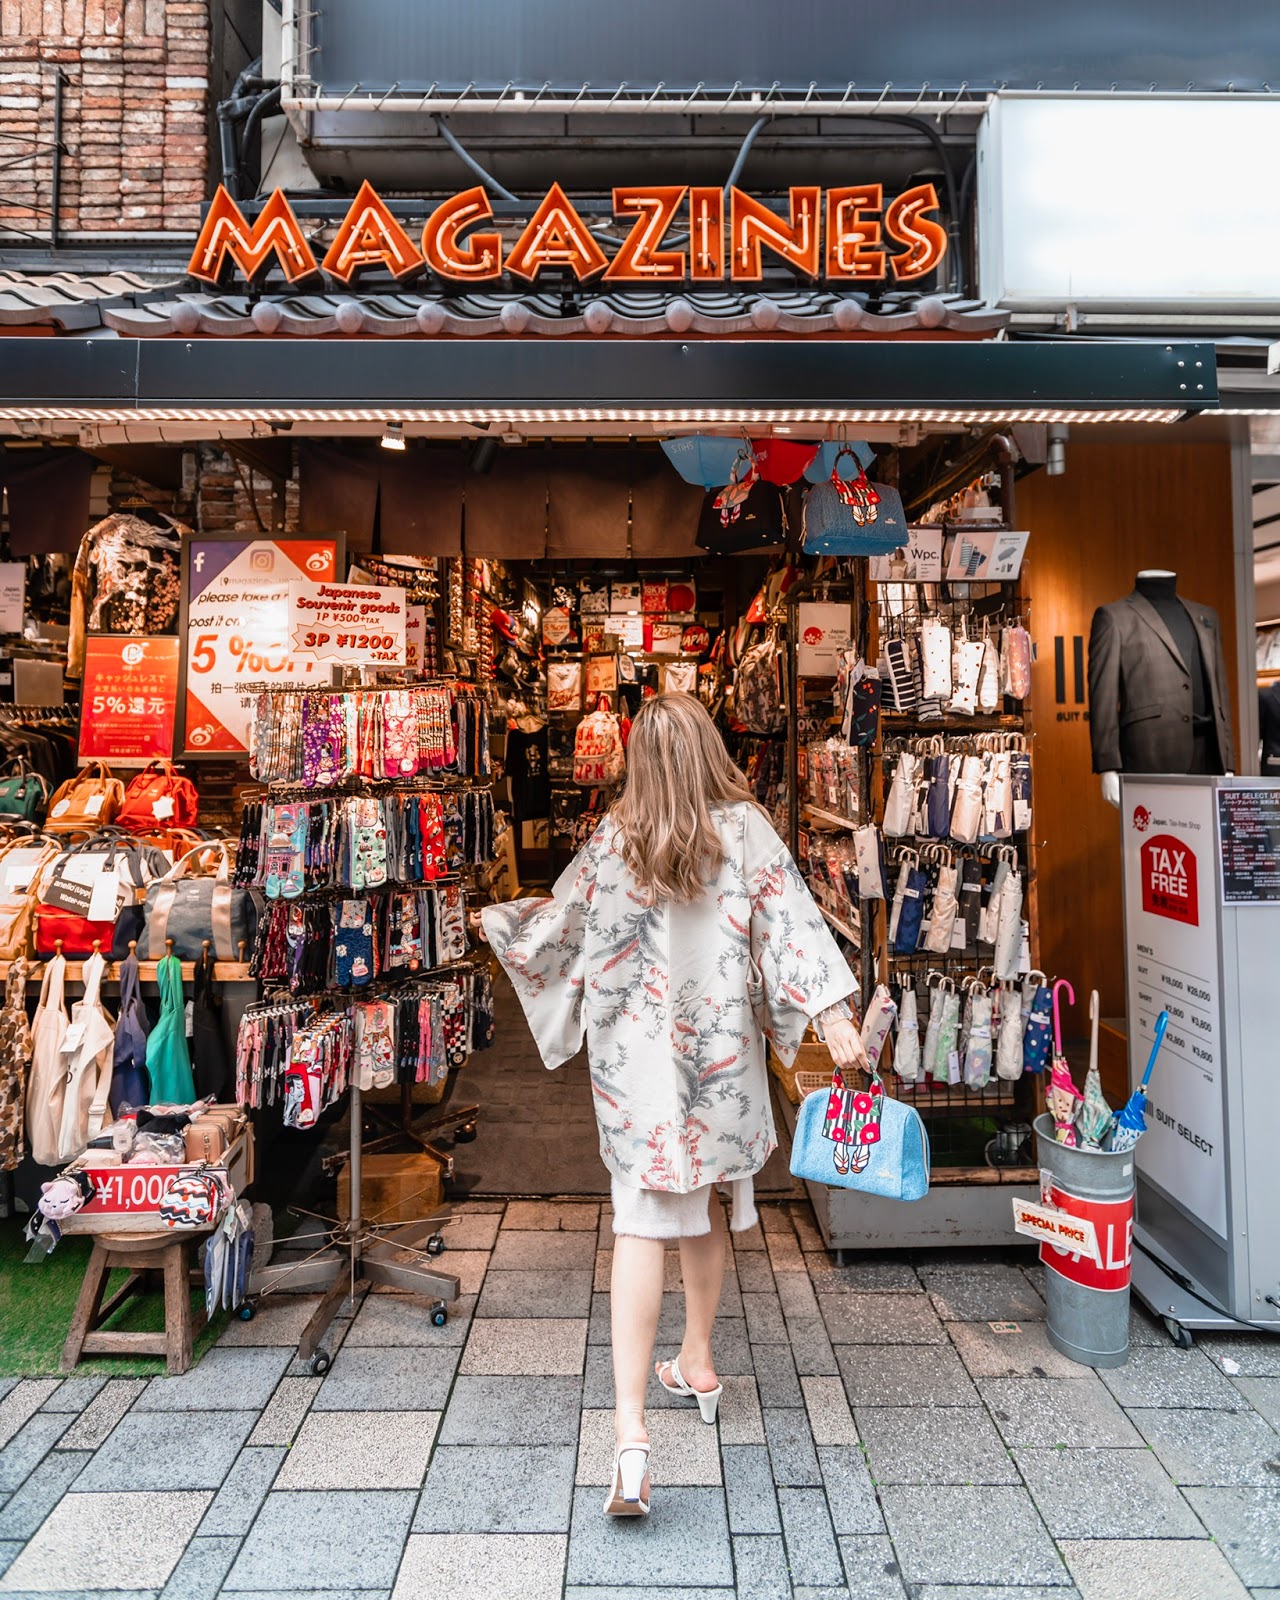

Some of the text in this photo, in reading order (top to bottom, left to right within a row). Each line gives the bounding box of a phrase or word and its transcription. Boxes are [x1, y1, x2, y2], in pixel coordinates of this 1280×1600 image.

[187, 179, 948, 285] MAGAZINES
[911, 549, 939, 560] Wpc.
[197, 591, 239, 605] please
[316, 585, 381, 600] Japanese
[296, 596, 357, 612] Souvenir
[360, 602, 401, 615] goods
[188, 615, 214, 629] post
[316, 612, 330, 621] 1P
[304, 632, 394, 649] 3P ¥1200
[191, 634, 219, 674] 5
[370, 651, 398, 661] +TAX
[92, 696, 165, 715] 5%還元
[1056, 711, 1080, 722] SUIT
[1224, 792, 1241, 800] SUIT
[1242, 792, 1268, 800] SELECT
[1149, 846, 1187, 877] TAX
[1151, 872, 1188, 898] FREE
[1137, 944, 1153, 956] MEN'S
[1137, 965, 1211, 1002] SUIT ¥18,000 ¥28,000
[1164, 1003, 1184, 1019] ¥2,800
[1190, 1014, 1212, 1033] ¥3,800
[1166, 1031, 1186, 1049] ¥2,800
[1192, 1045, 1213, 1064] ¥3,800
[1156, 1107, 1214, 1158] SUIT SELECT
[1021, 1212, 1085, 1243] SPECIAL PRICE
